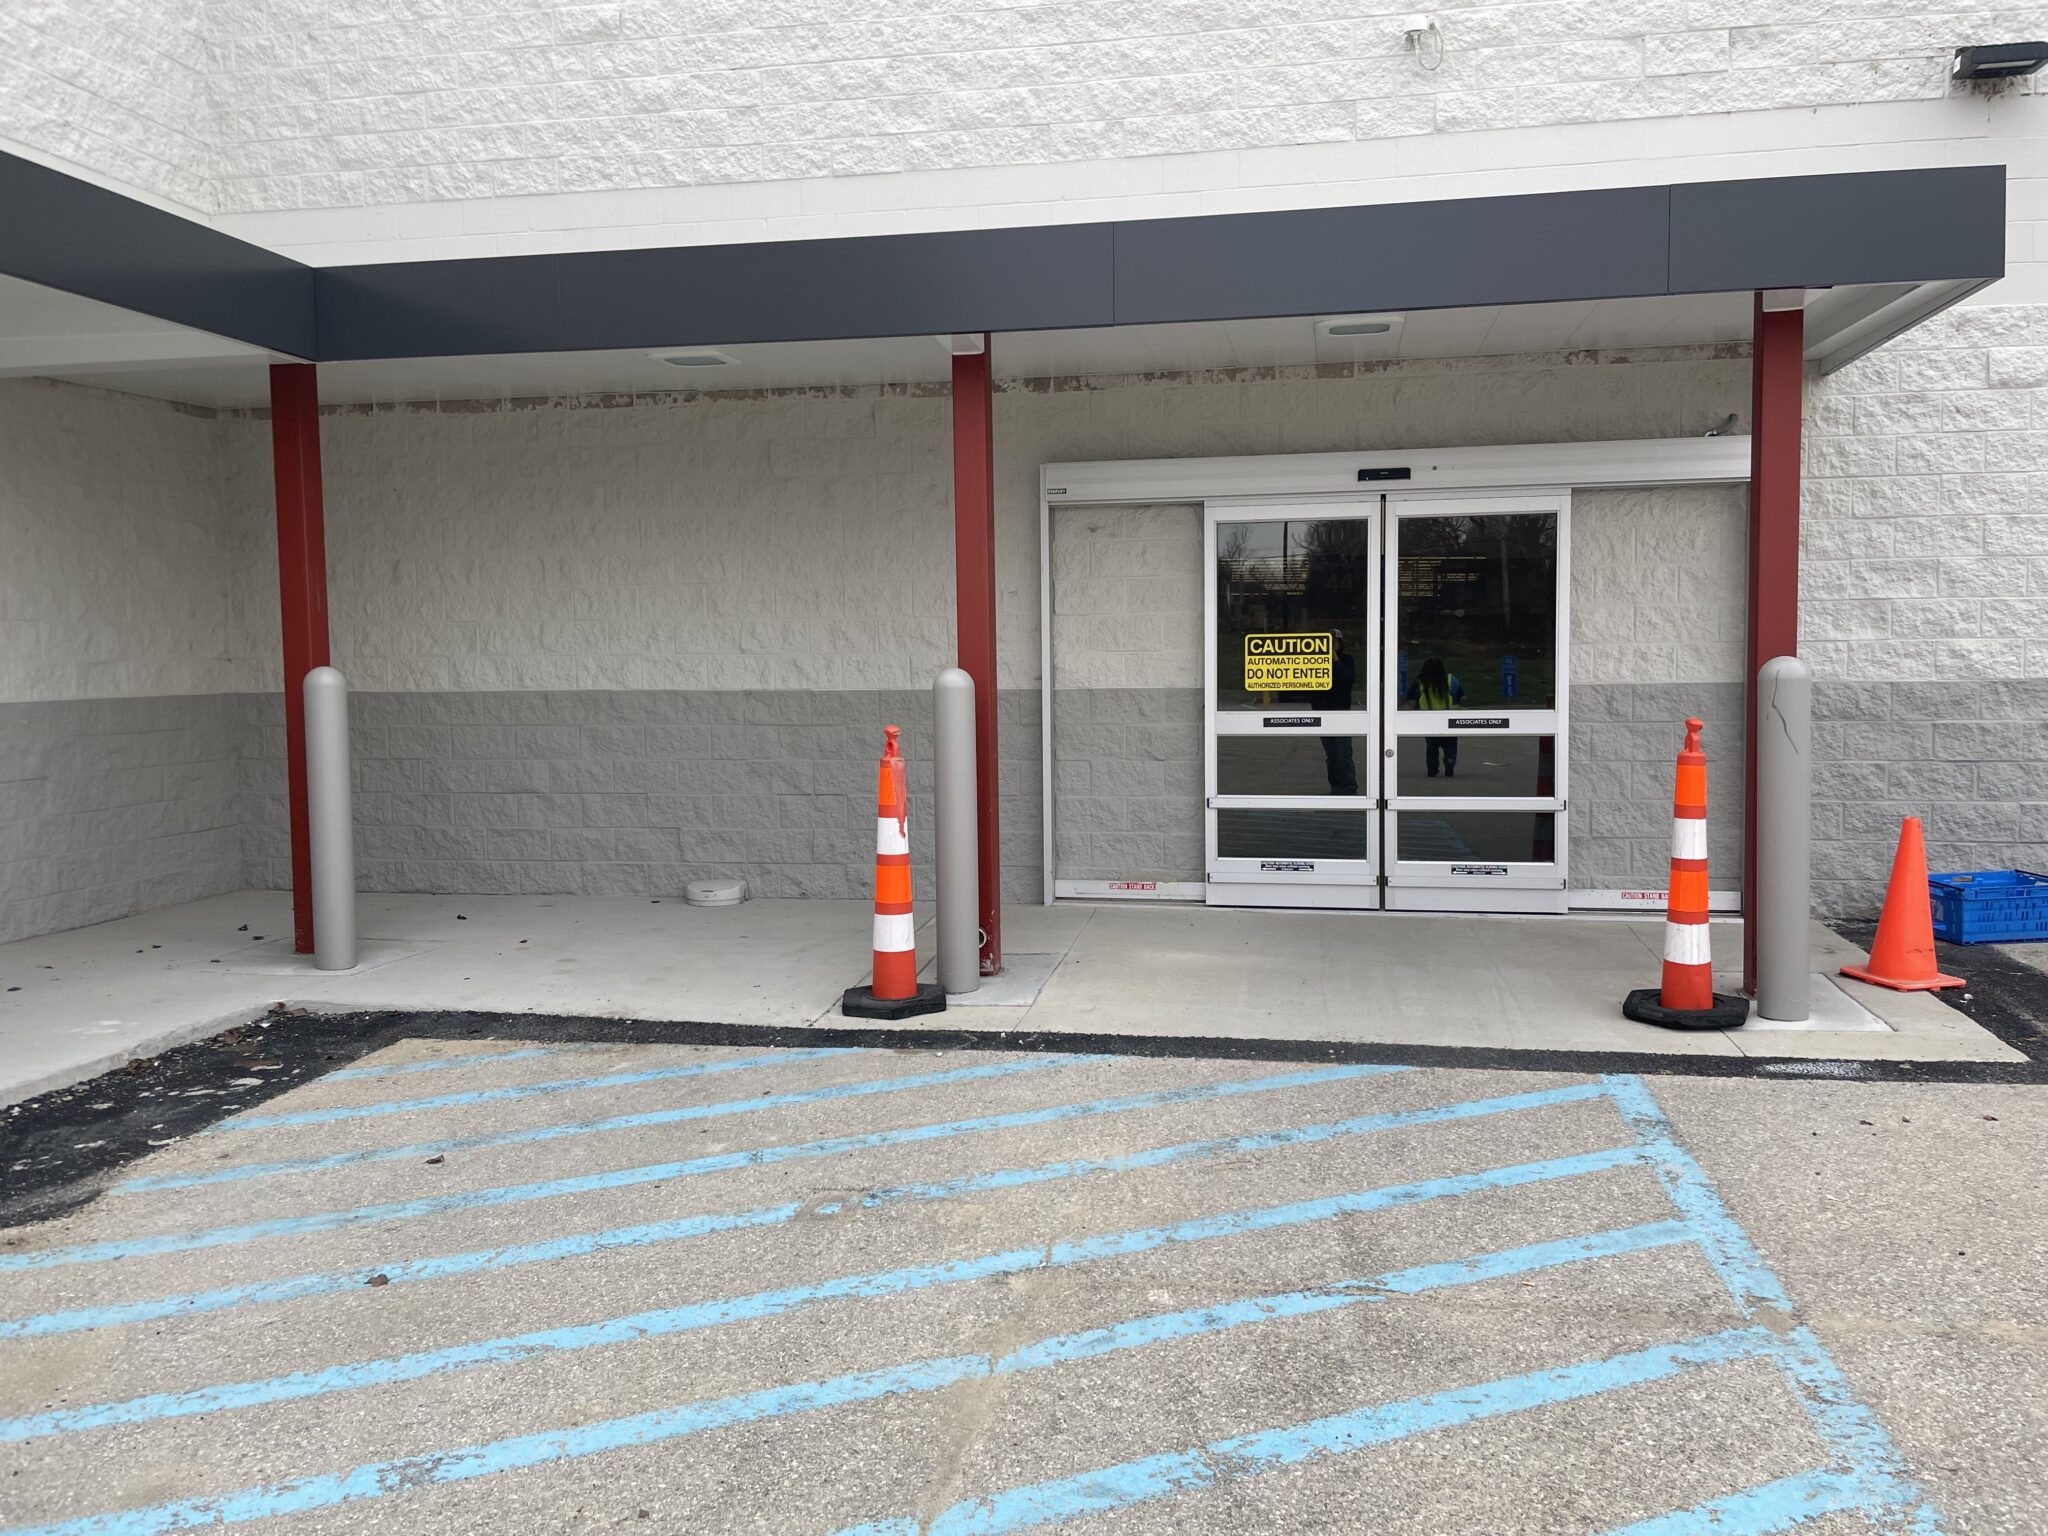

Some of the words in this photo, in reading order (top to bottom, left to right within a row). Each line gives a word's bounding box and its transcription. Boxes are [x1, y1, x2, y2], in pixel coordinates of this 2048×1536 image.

[1250, 638, 1327, 653] CAUTION
[1248, 657, 1300, 666] AUTOMATIC
[1303, 657, 1330, 665] DOOR
[1248, 668, 1263, 679] DO
[1267, 668, 1290, 679] NOT
[1293, 668, 1329, 678] ENTER
